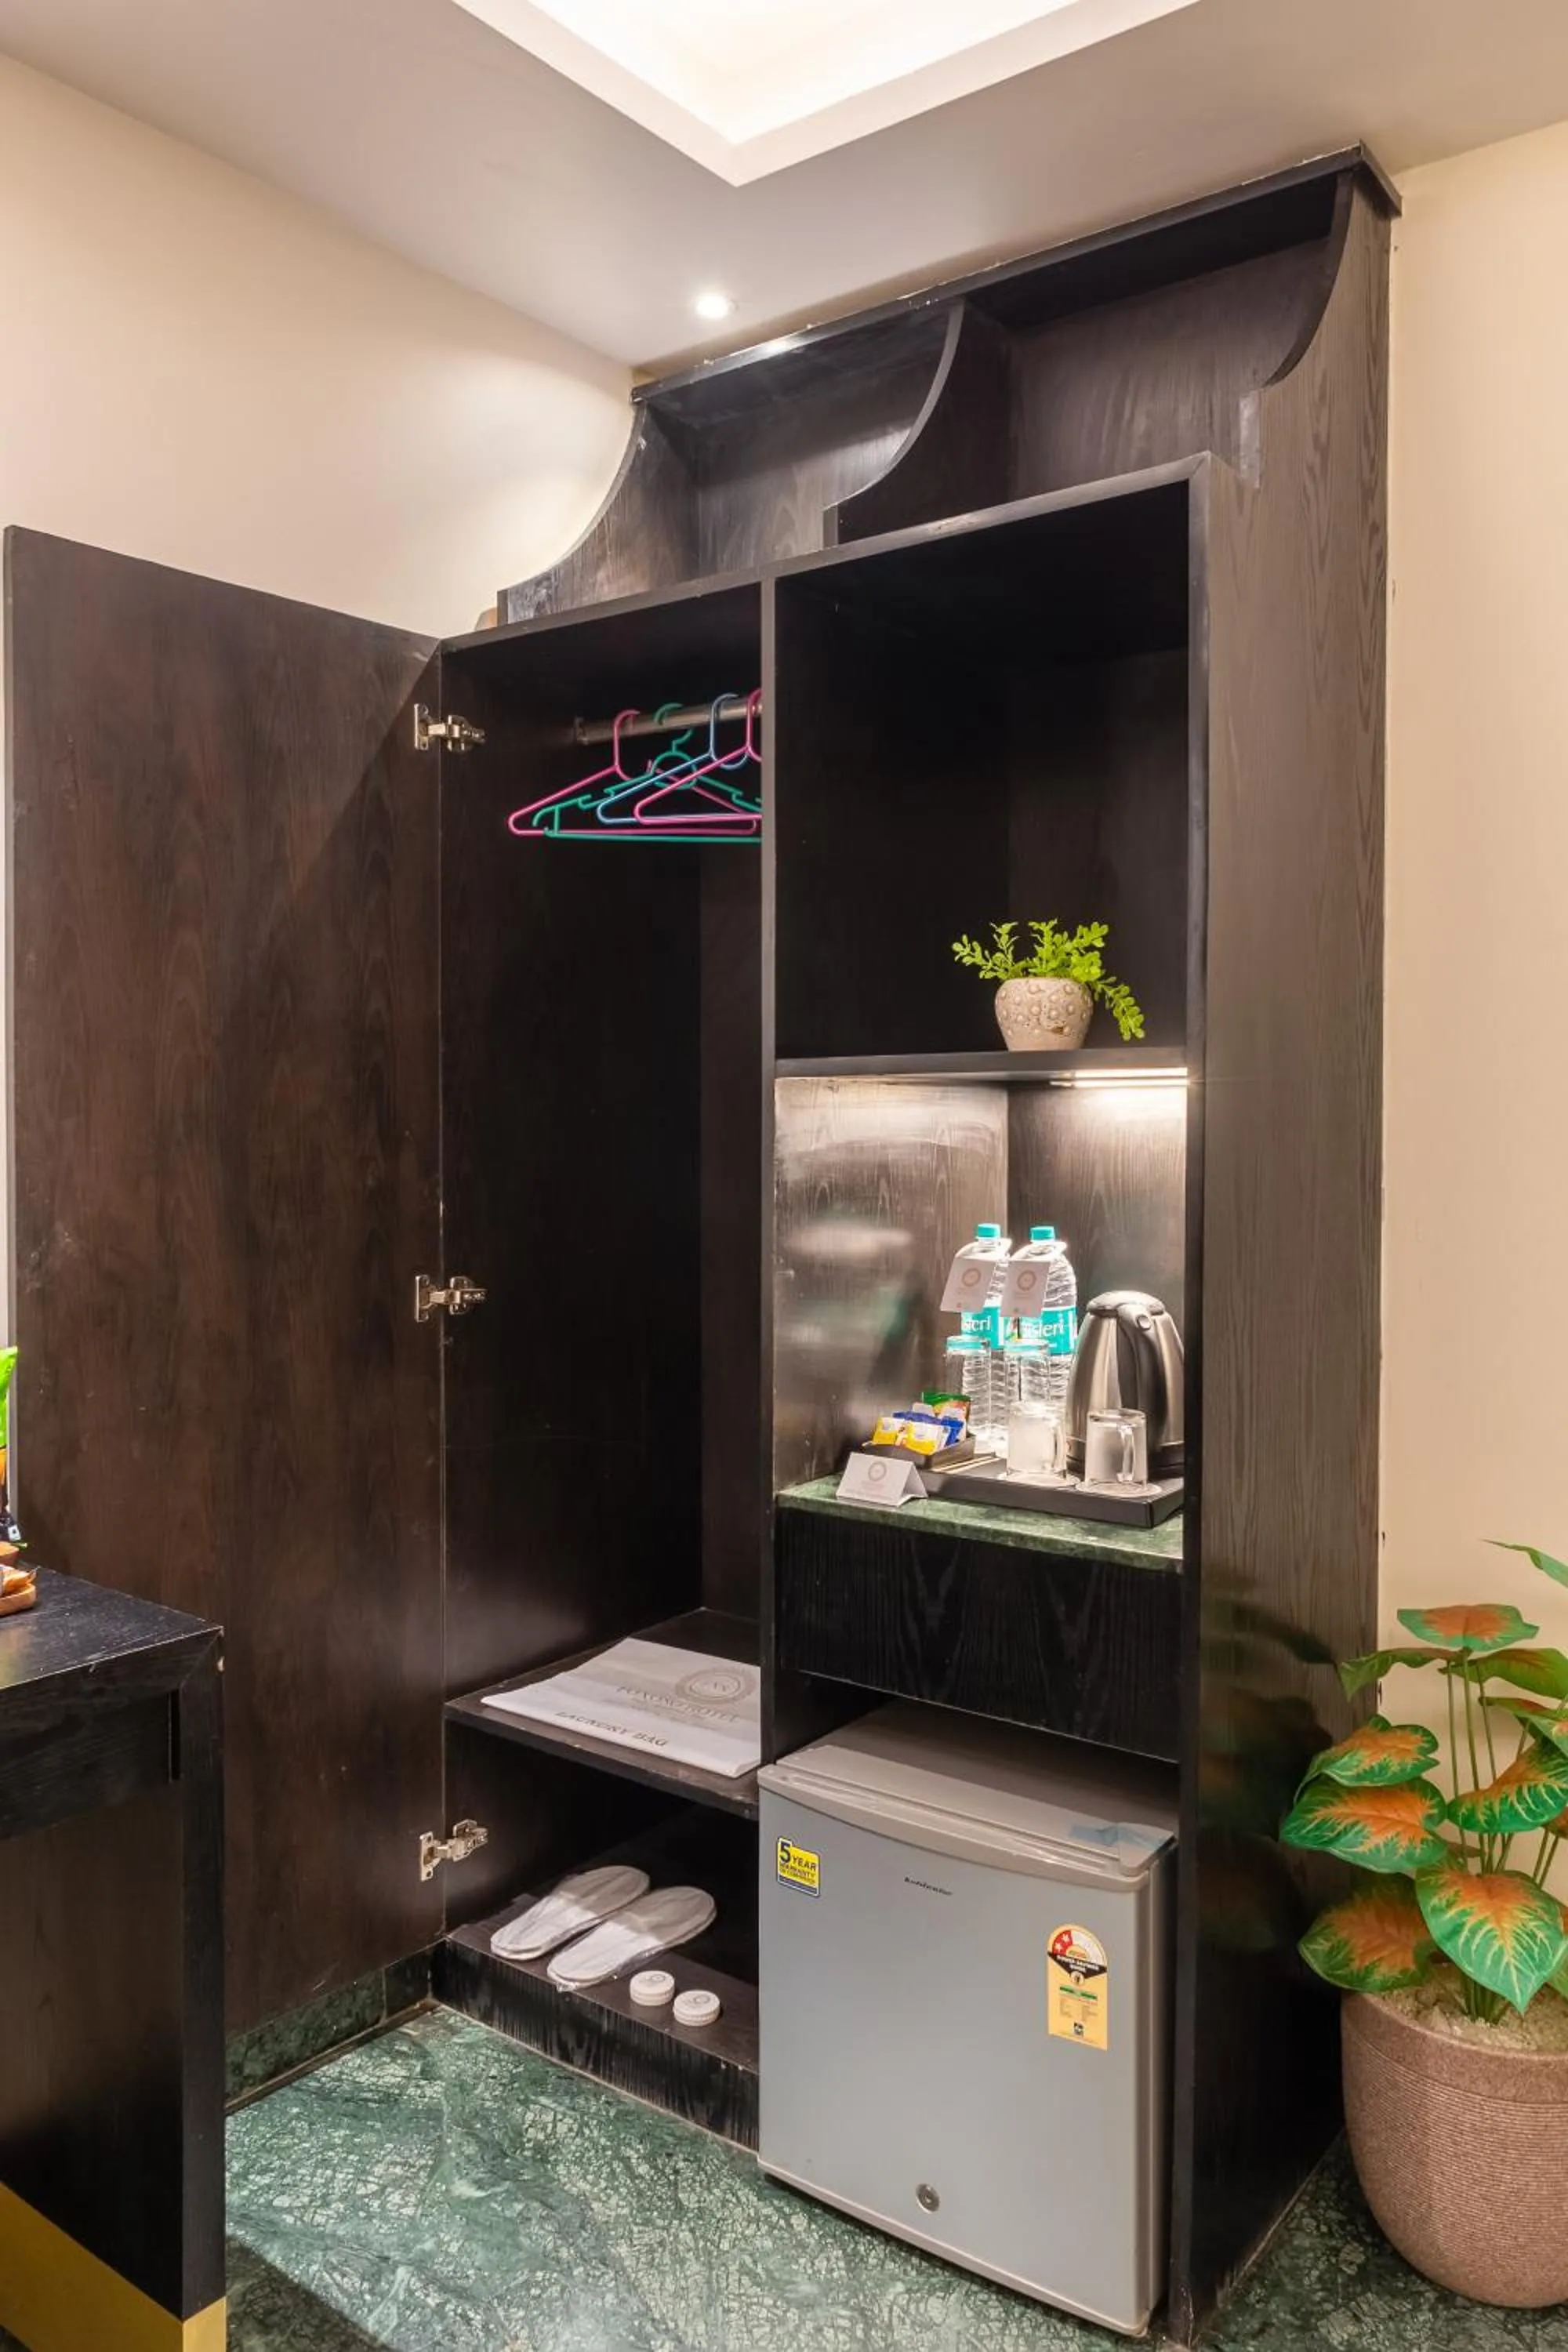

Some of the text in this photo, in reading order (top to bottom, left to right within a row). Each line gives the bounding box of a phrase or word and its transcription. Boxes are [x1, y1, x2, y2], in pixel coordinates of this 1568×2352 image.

[632, 1731, 669, 1748] BAG
[780, 1842, 817, 1872] 5 YEAR
